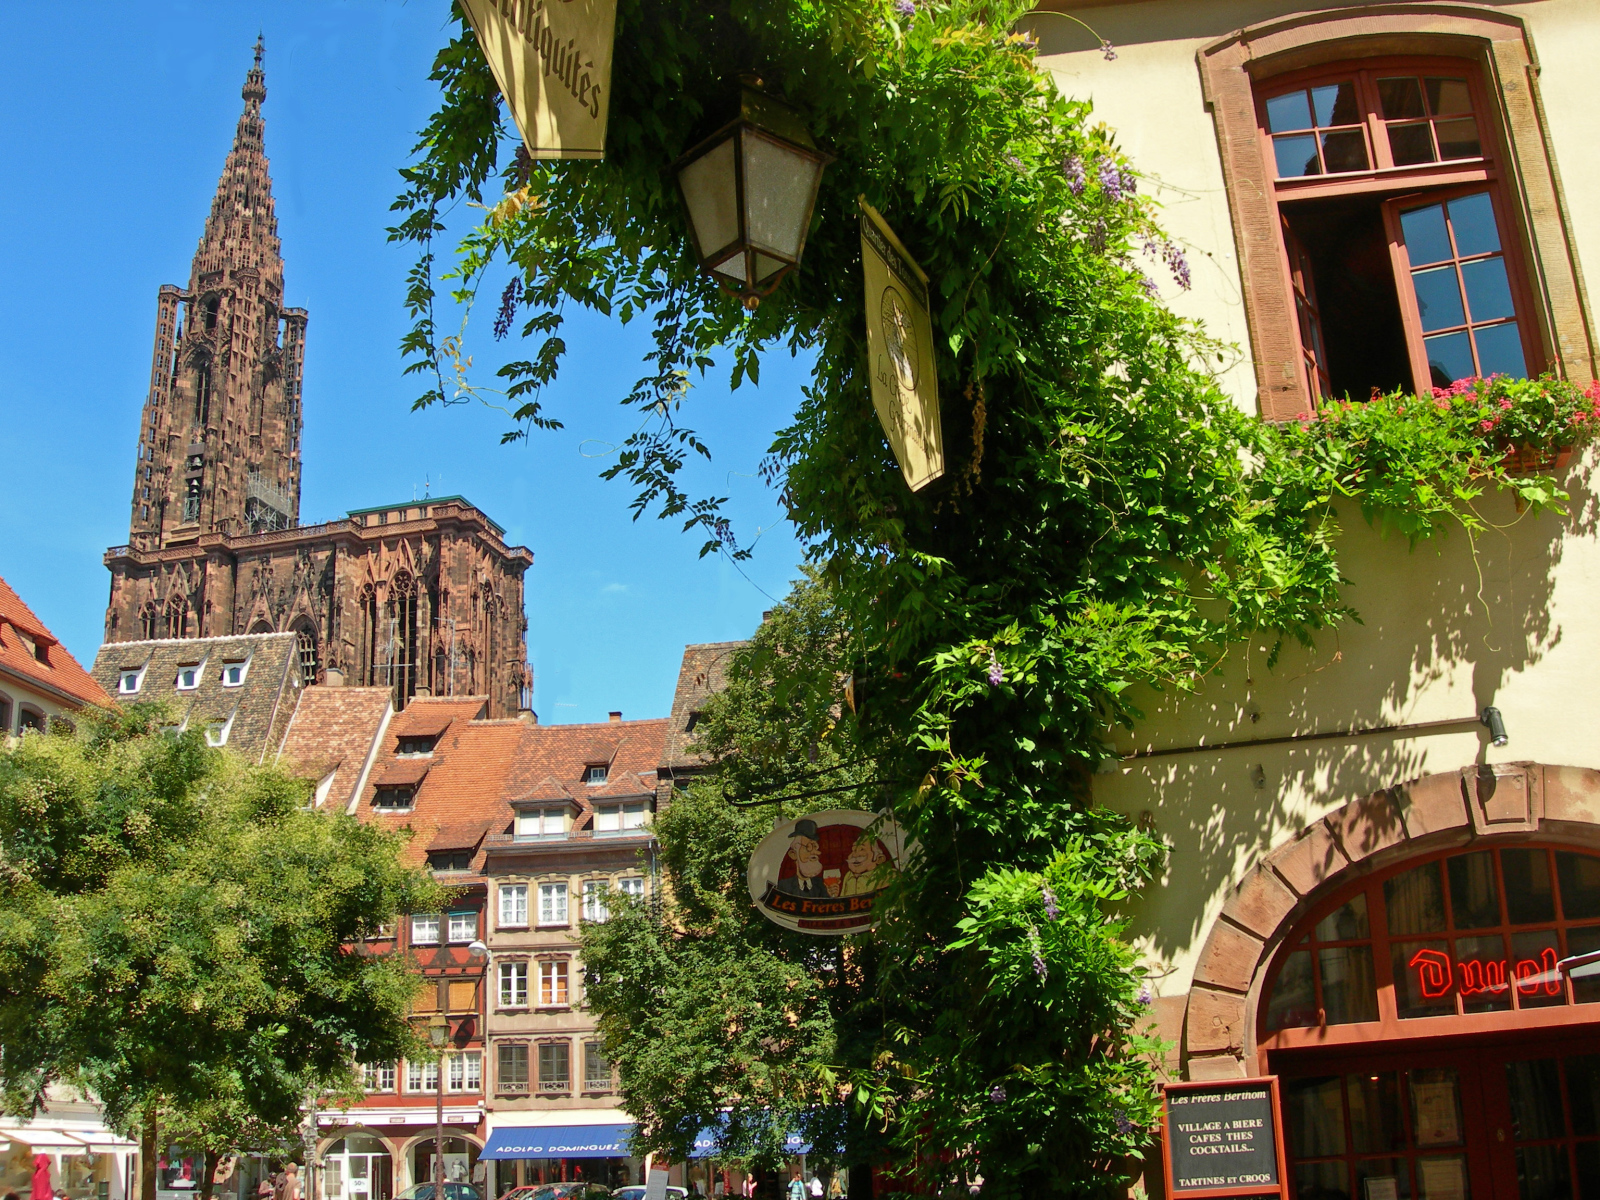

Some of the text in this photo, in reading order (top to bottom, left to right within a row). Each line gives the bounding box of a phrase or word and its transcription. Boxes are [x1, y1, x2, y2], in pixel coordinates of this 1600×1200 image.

[772, 895, 796, 911] Les
[802, 901, 845, 913] Frères
[1409, 947, 1562, 998] Duvel
[1171, 1095, 1189, 1105] Les
[1224, 1091, 1267, 1102] Berthom
[1178, 1119, 1264, 1132] VILLAGE A BIERE
[1189, 1131, 1254, 1144] CAFES THES
[548, 1143, 620, 1152] DOMINGUEZ
[1190, 1143, 1255, 1155] COCKTAILS...
[1179, 1173, 1271, 1187] TARTINES ET CROQS
